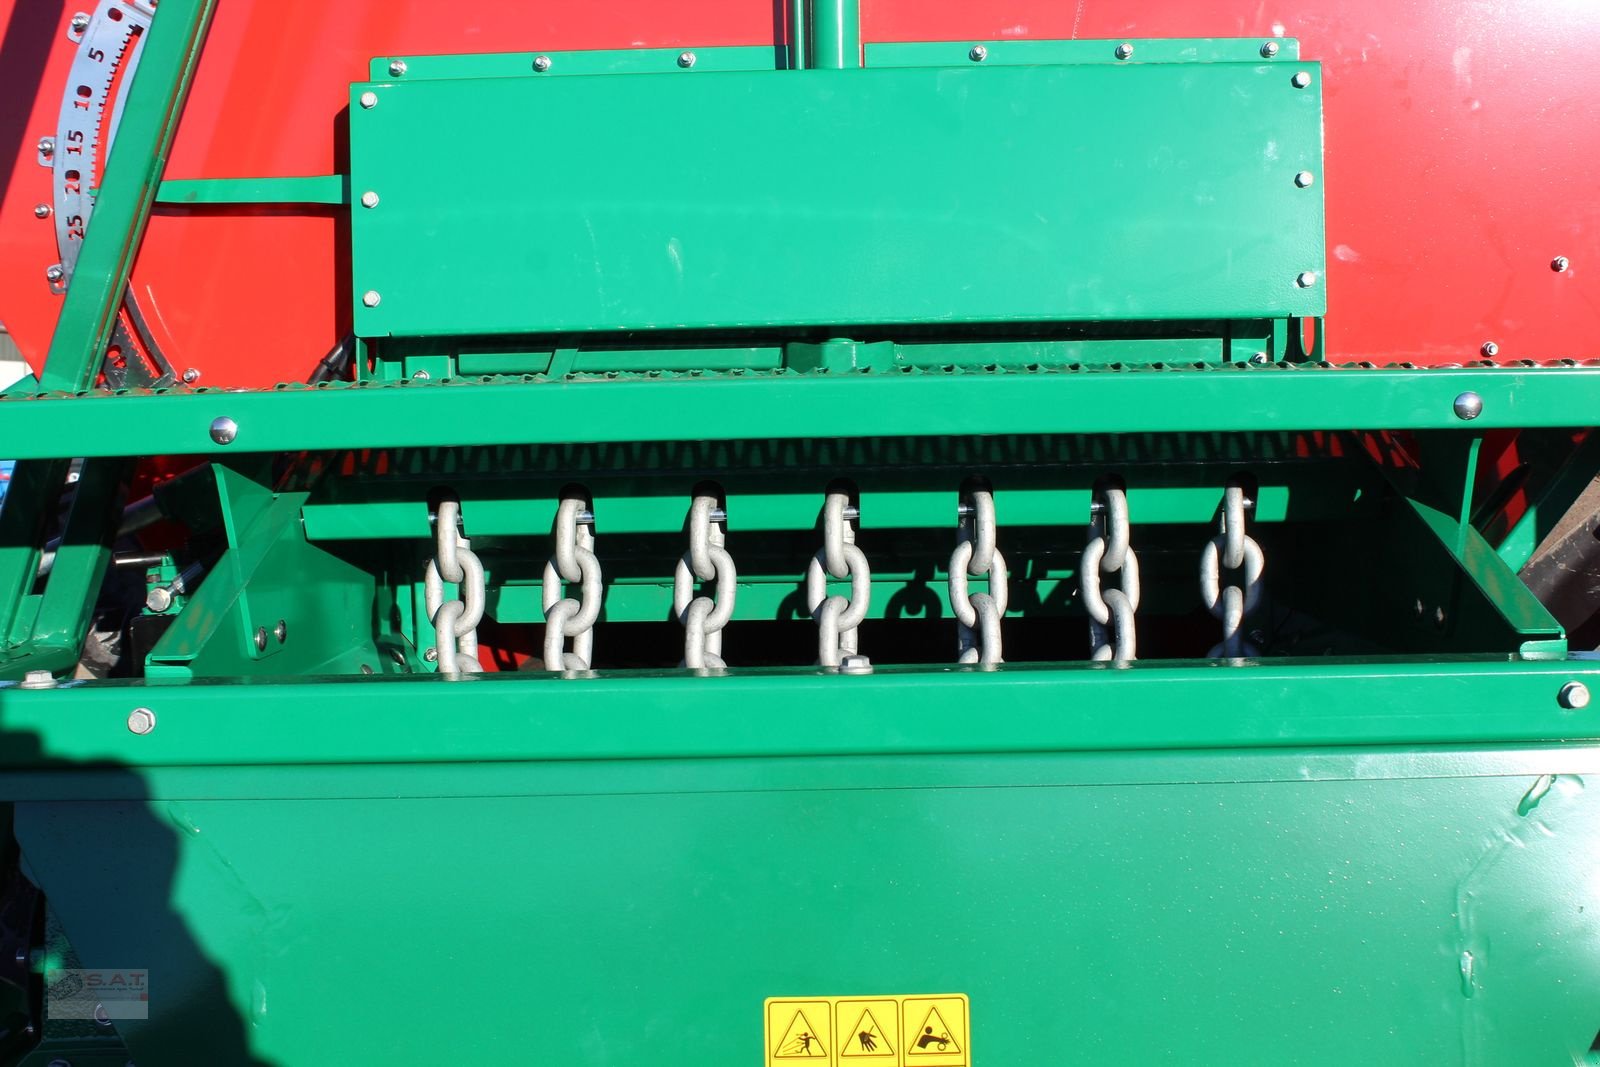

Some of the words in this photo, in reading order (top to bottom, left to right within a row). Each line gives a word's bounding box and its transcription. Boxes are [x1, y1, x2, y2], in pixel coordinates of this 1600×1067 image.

[107, 7, 123, 21] 0
[88, 47, 104, 63] 5
[74, 85, 93, 111] 10
[66, 130, 84, 156] 15
[64, 169, 81, 195] 20
[67, 215, 84, 240] 25
